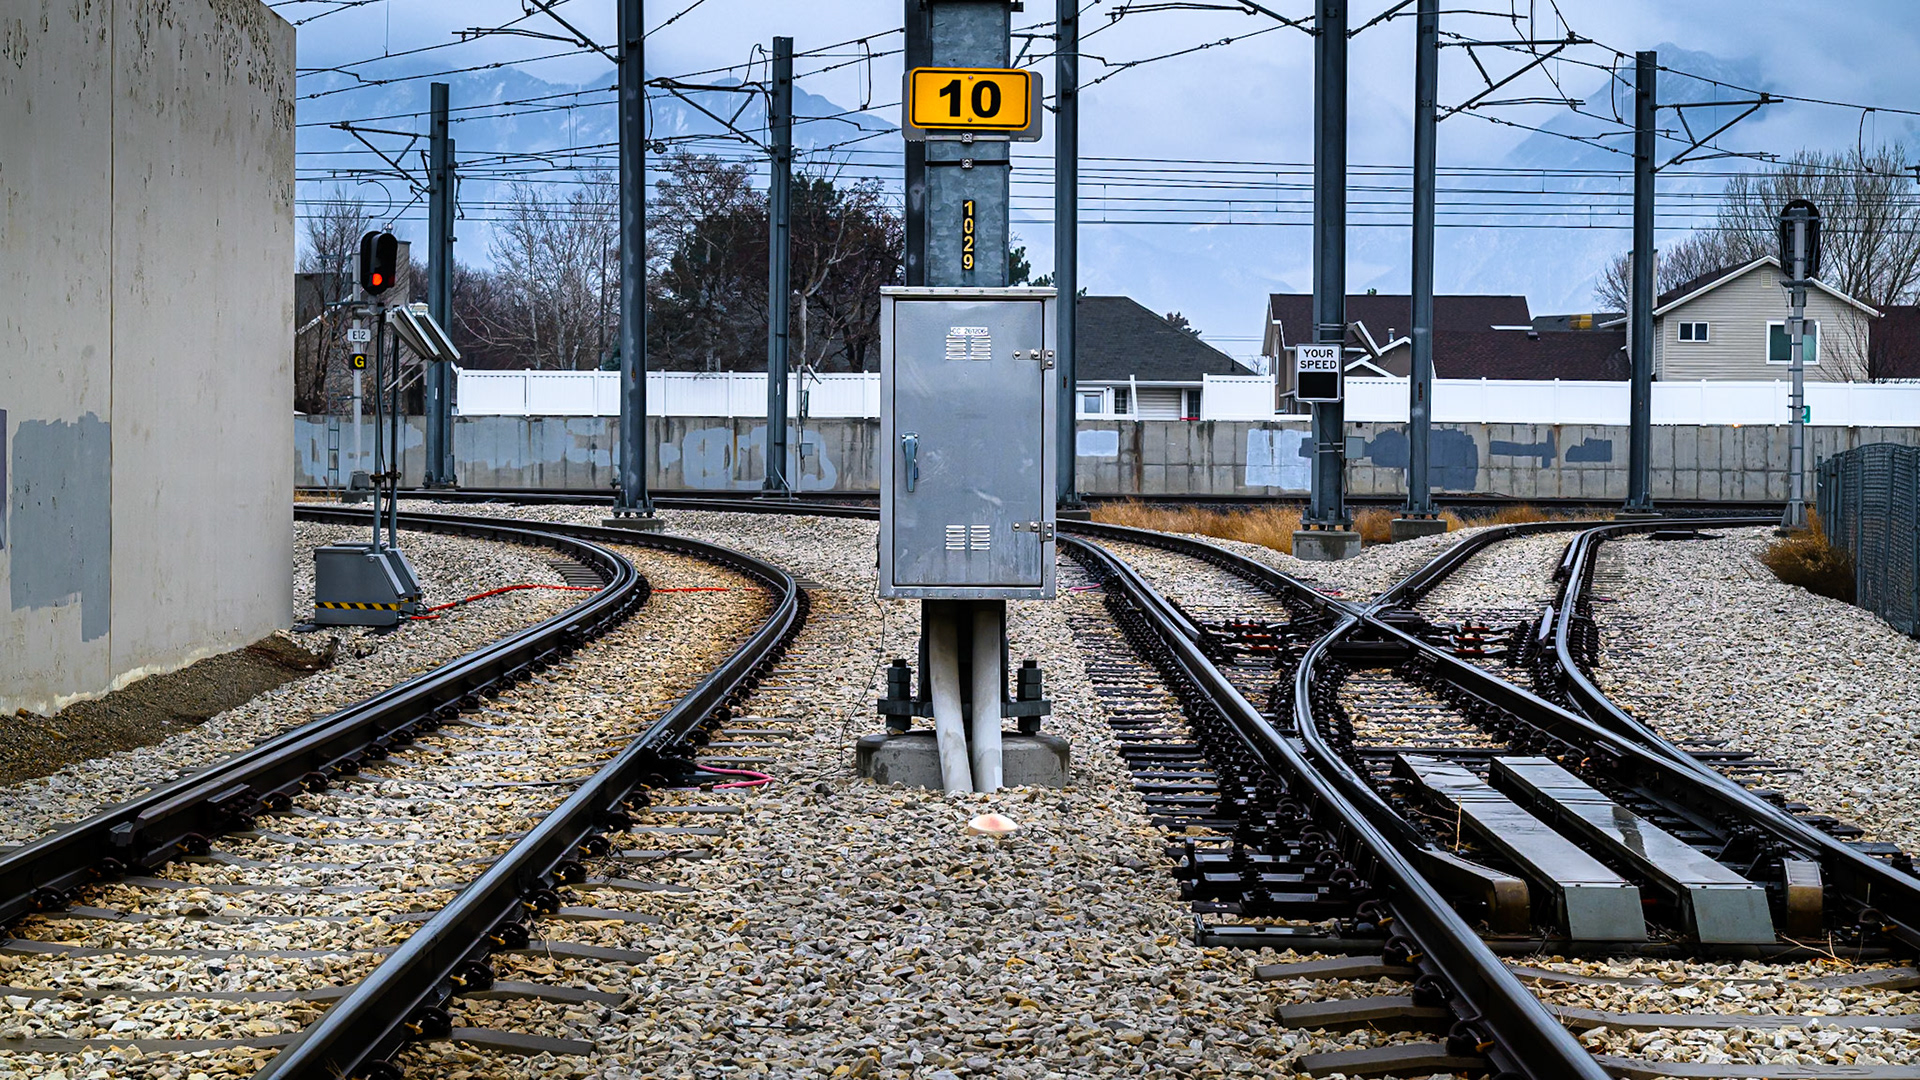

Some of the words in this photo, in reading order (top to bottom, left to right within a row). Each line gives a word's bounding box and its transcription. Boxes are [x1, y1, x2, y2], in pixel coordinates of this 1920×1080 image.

[939, 79, 1002, 118] 10
[963, 200, 974, 270] 1029
[352, 330, 366, 340] E12
[1303, 348, 1334, 358] YOUR
[354, 355, 365, 368] G
[1300, 360, 1337, 369] SPEED
